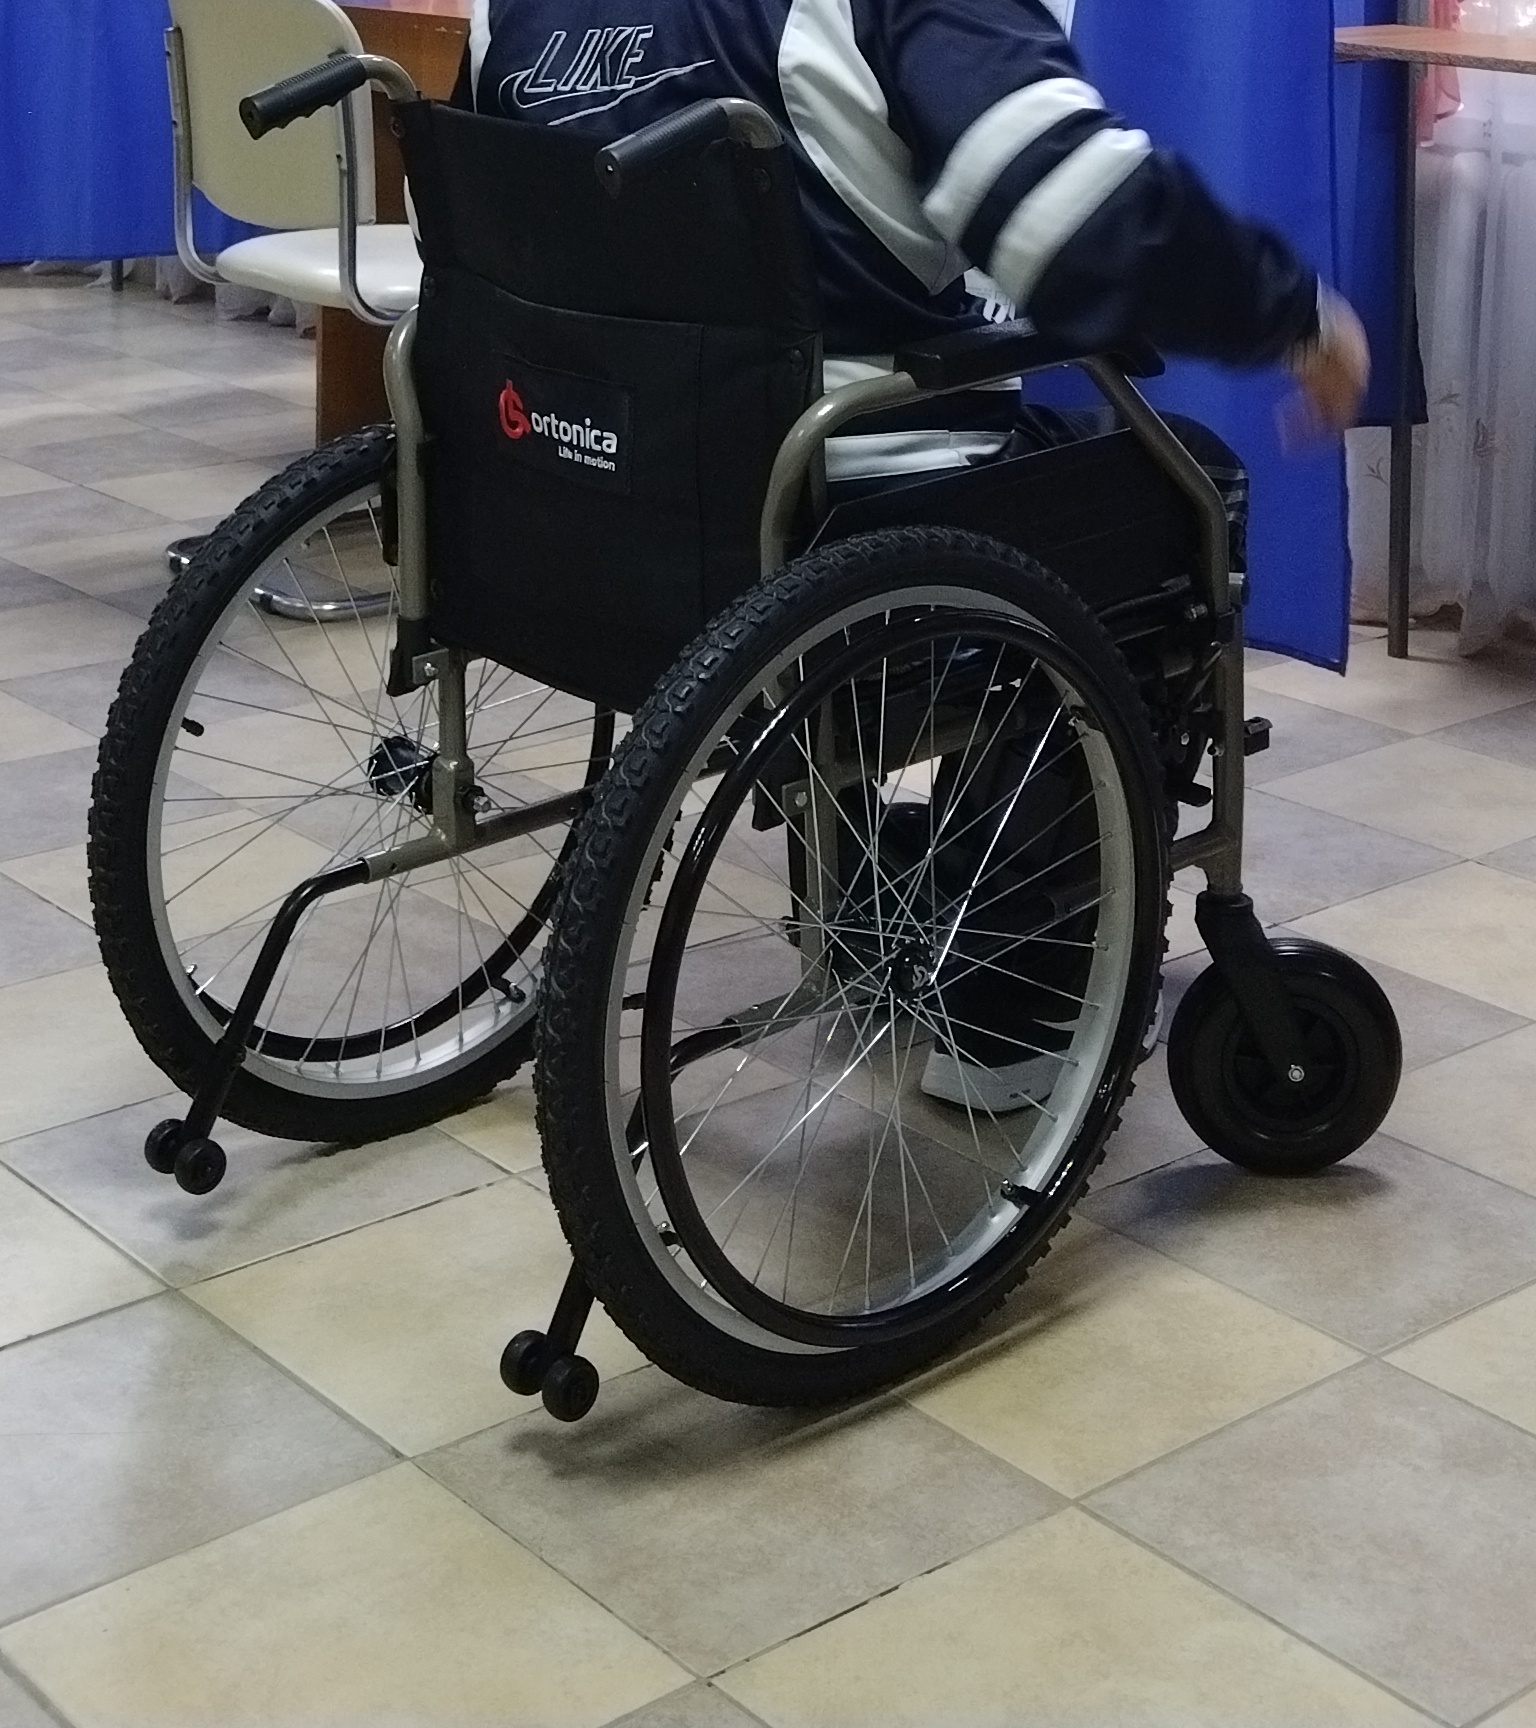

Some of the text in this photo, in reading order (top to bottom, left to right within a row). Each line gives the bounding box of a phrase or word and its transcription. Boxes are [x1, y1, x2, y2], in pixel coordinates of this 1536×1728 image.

[524, 25, 654, 93] LIKE
[531, 412, 618, 454] ortonica
[574, 449, 582, 463] in
[583, 454, 616, 472] motion
